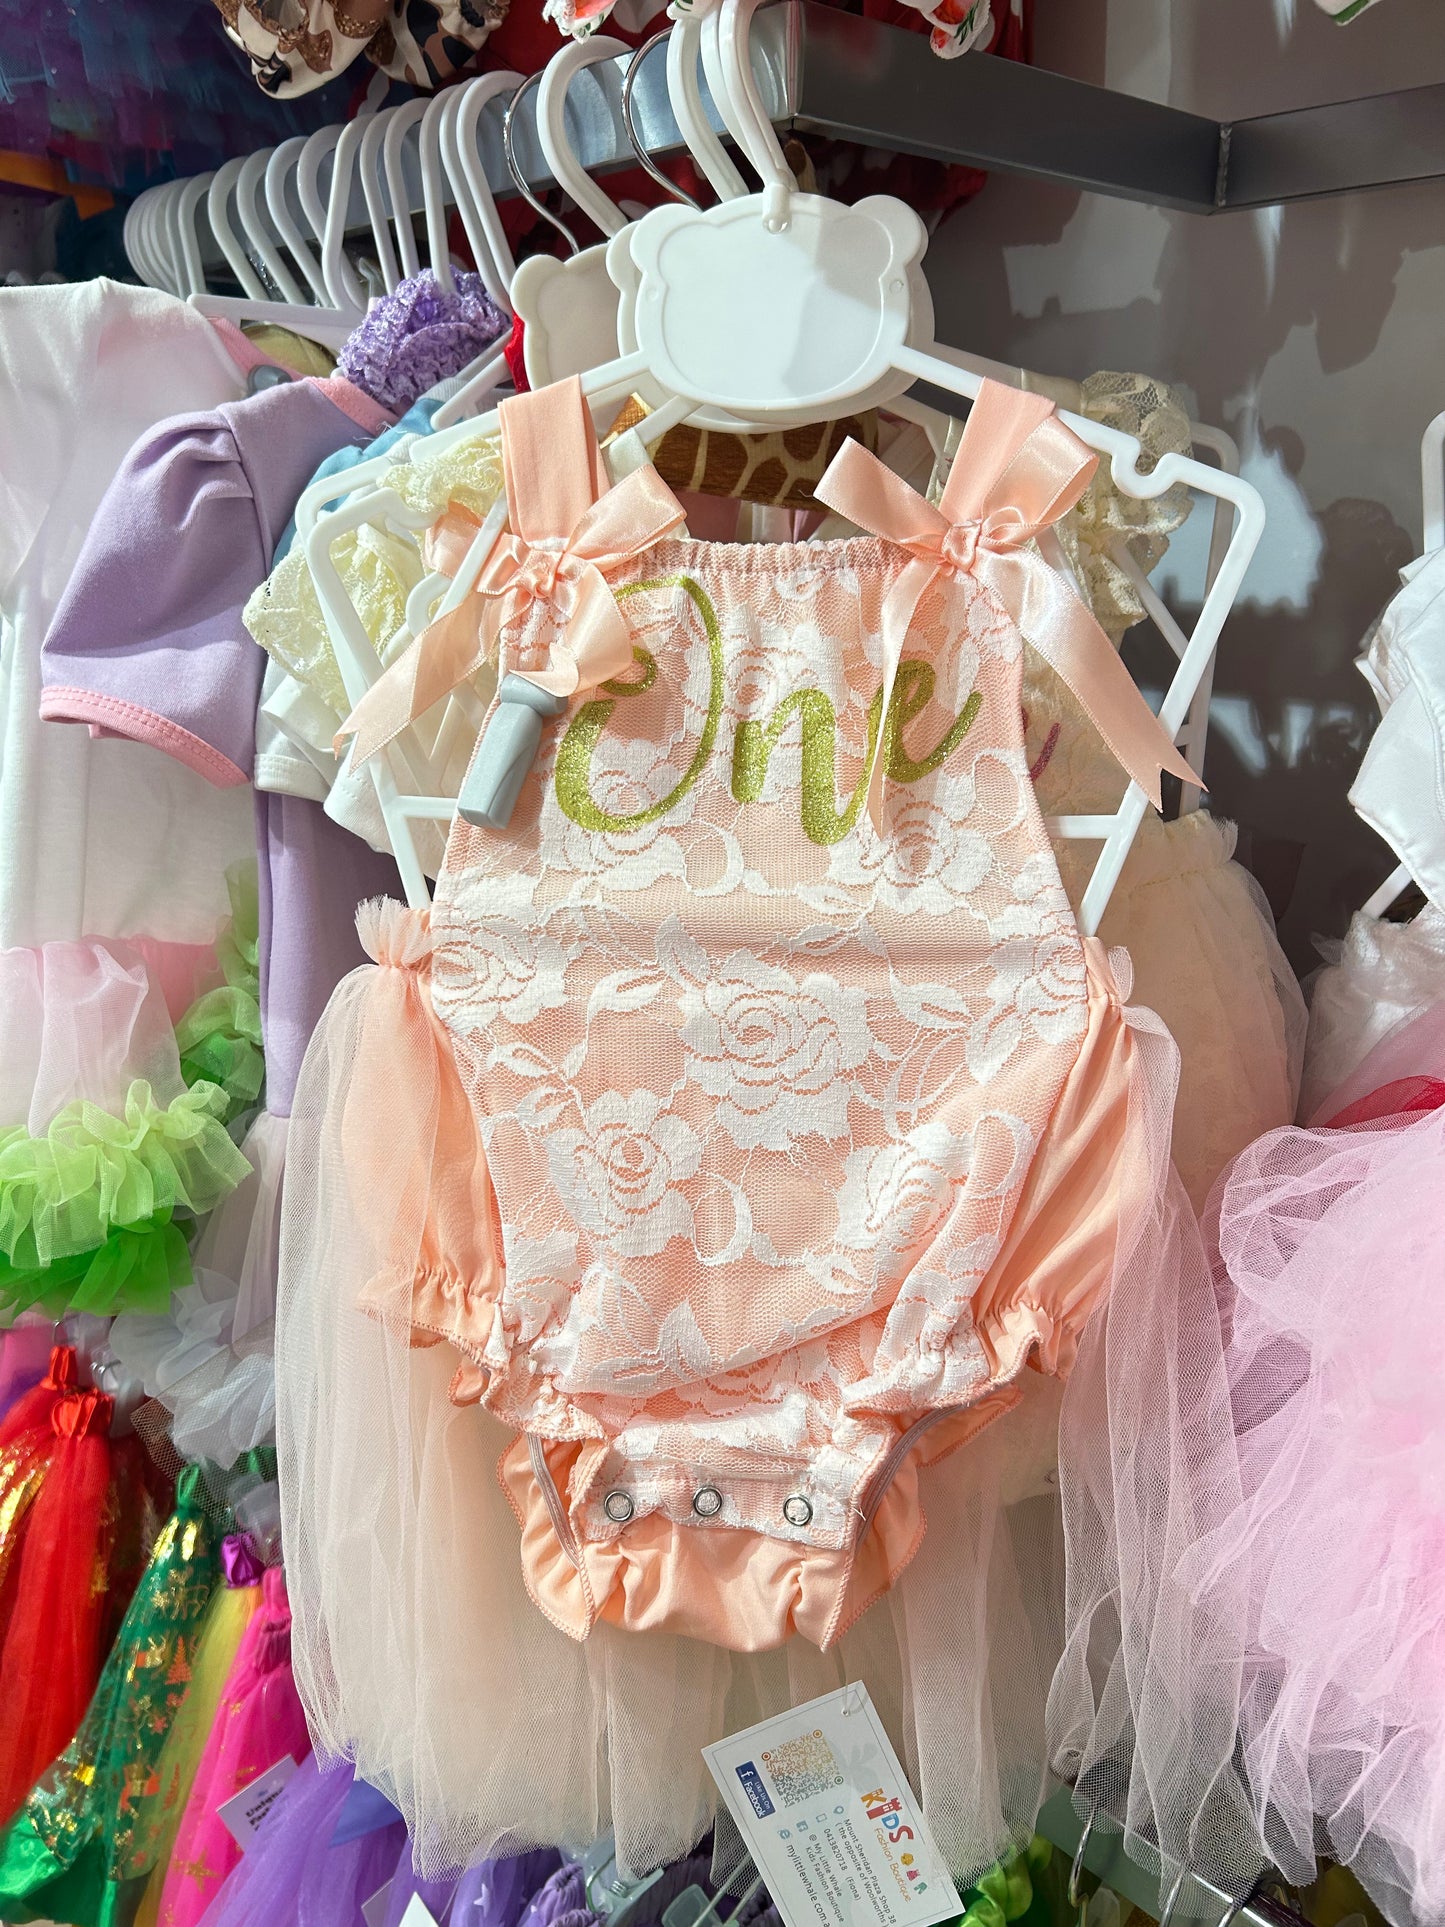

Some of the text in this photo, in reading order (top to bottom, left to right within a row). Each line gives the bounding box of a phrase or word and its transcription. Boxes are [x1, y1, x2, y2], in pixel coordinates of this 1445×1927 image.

[555, 575, 983, 845] One
[743, 1781, 767, 1818] Facebook
[805, 1846, 845, 1922] Kids Fashion Boutique
[813, 1842, 823, 1855] My
[819, 1855, 831, 1874] Little
[829, 1874, 842, 1897] Whale
[823, 1828, 861, 1901] 0413820718 (Fiona)
[838, 1827, 847, 1840] the
[844, 1840, 862, 1872] opposite
[859, 1872, 869, 1881] of
[864, 1881, 886, 1923] Woolworths
[843, 1818, 897, 1924] Mount Sheridan Plaza Shop 38
[874, 1827, 912, 1903] Fashion Boutique
